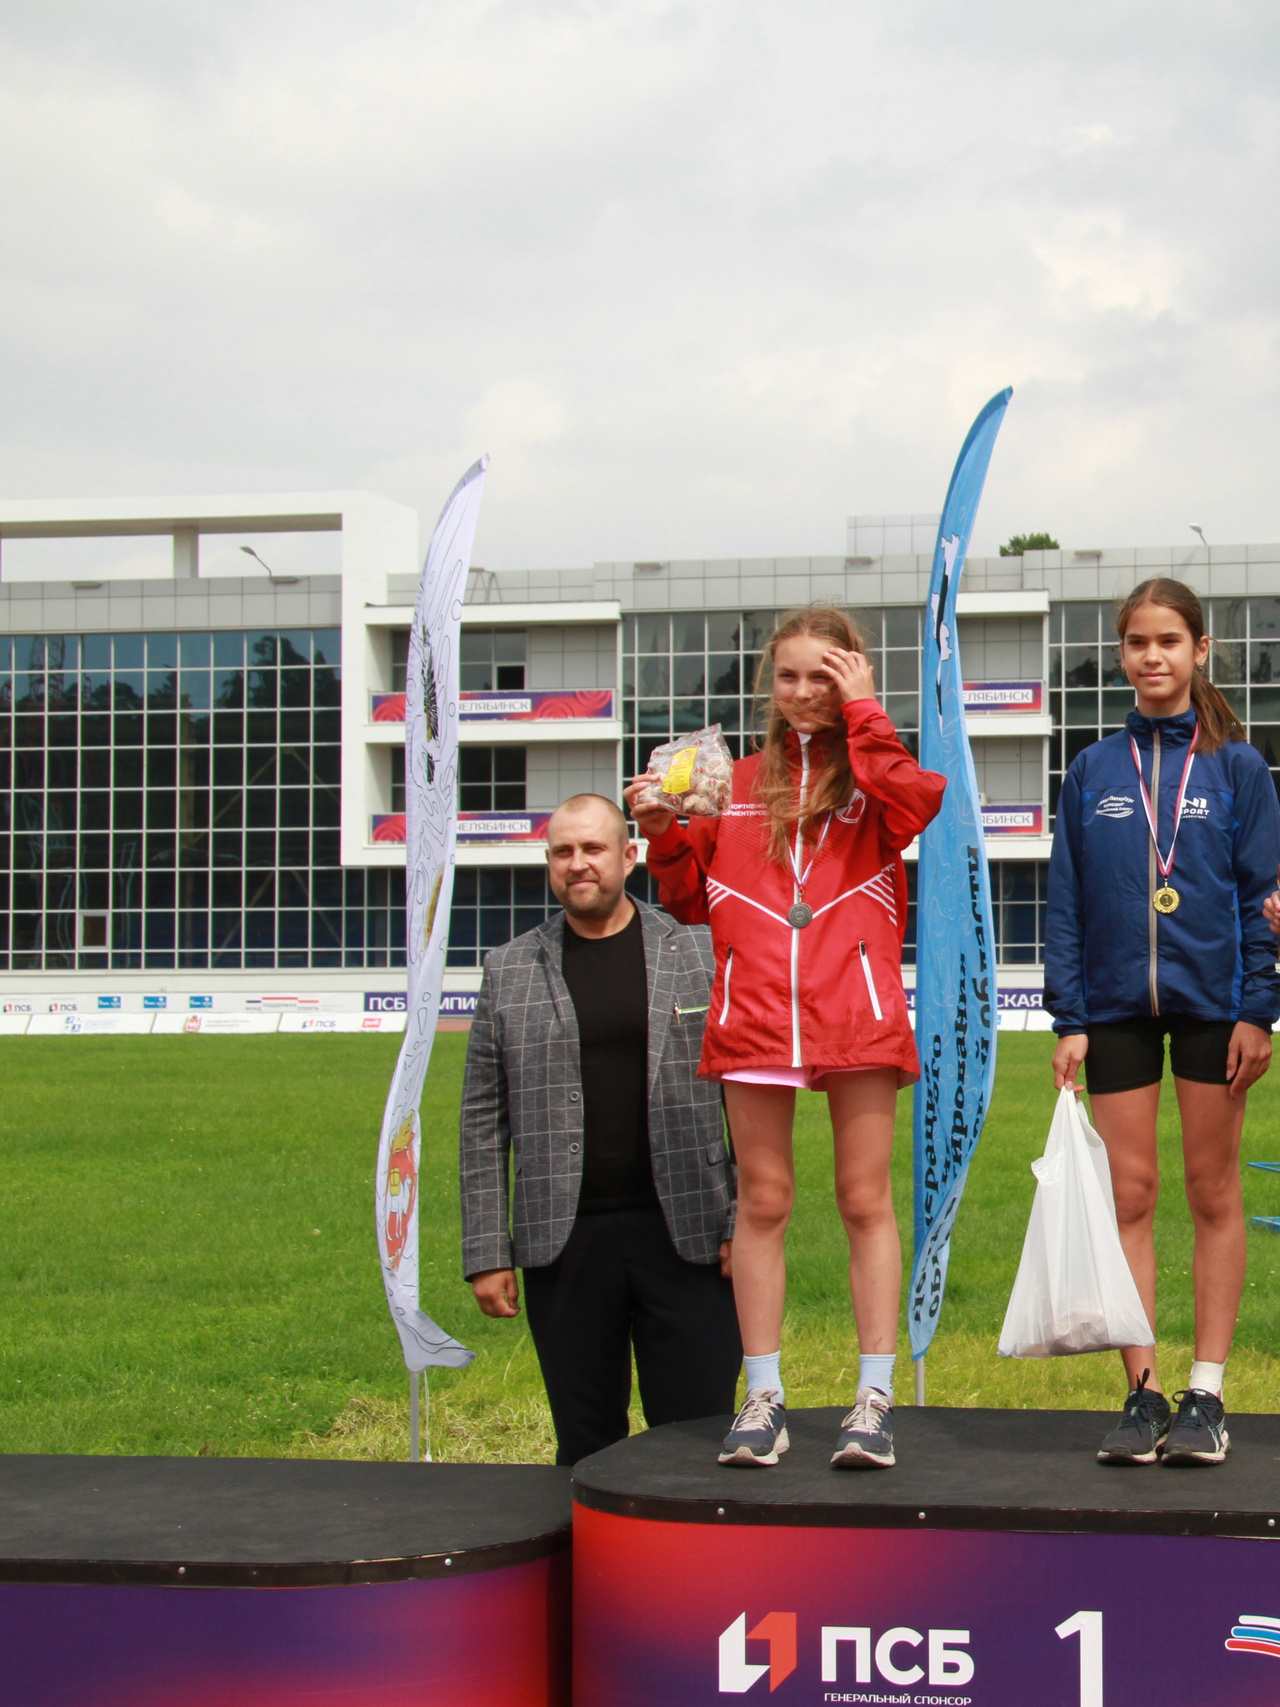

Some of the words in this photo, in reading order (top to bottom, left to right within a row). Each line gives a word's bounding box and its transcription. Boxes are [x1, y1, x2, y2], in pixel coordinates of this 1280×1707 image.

[963, 691, 1030, 702] ЕЛЯБИНСК
[369, 997, 406, 1010] ПСБ
[821, 1626, 975, 1686] ПСБ
[1054, 1610, 1103, 1707] 1
[823, 1692, 911, 1704] ГЕНЕРАЛЬНЫЙ
[914, 1695, 972, 1706] СПОНСОР
